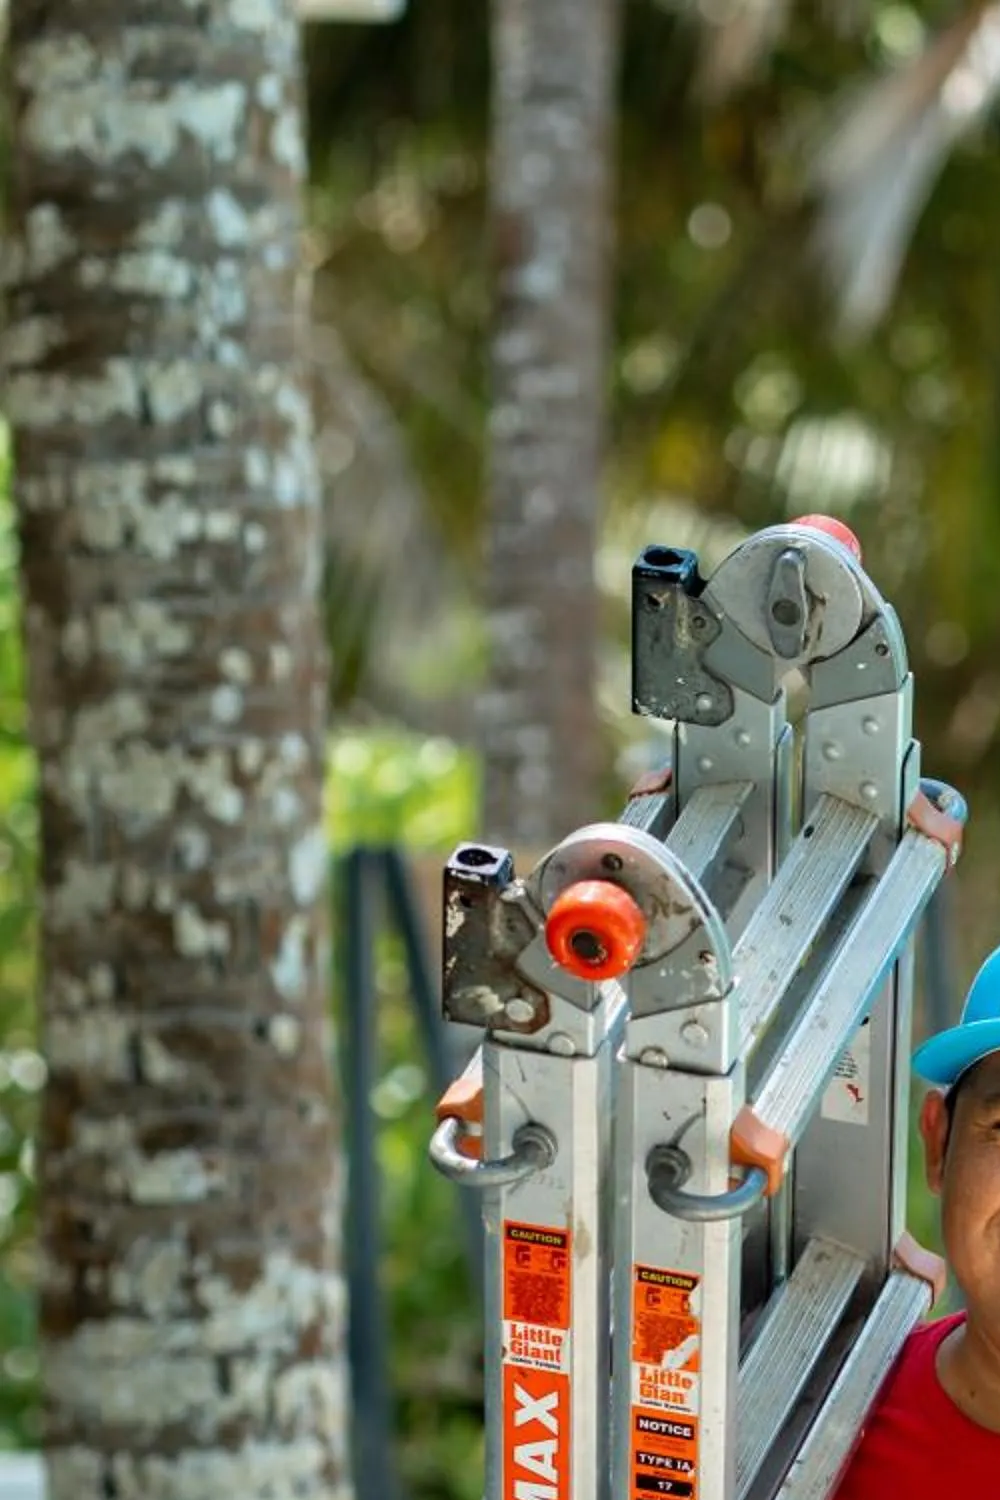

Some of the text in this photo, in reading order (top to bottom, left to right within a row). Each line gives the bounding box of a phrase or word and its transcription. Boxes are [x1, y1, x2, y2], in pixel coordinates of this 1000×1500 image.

[511, 1229, 562, 1245] CAUTION
[641, 1271, 693, 1288] CAUTION
[511, 1324, 563, 1346] Little
[511, 1340, 561, 1362] Giant
[640, 1366, 693, 1389] Little
[639, 1419, 692, 1437] NOTICE
[639, 1453, 673, 1468] TYPE
